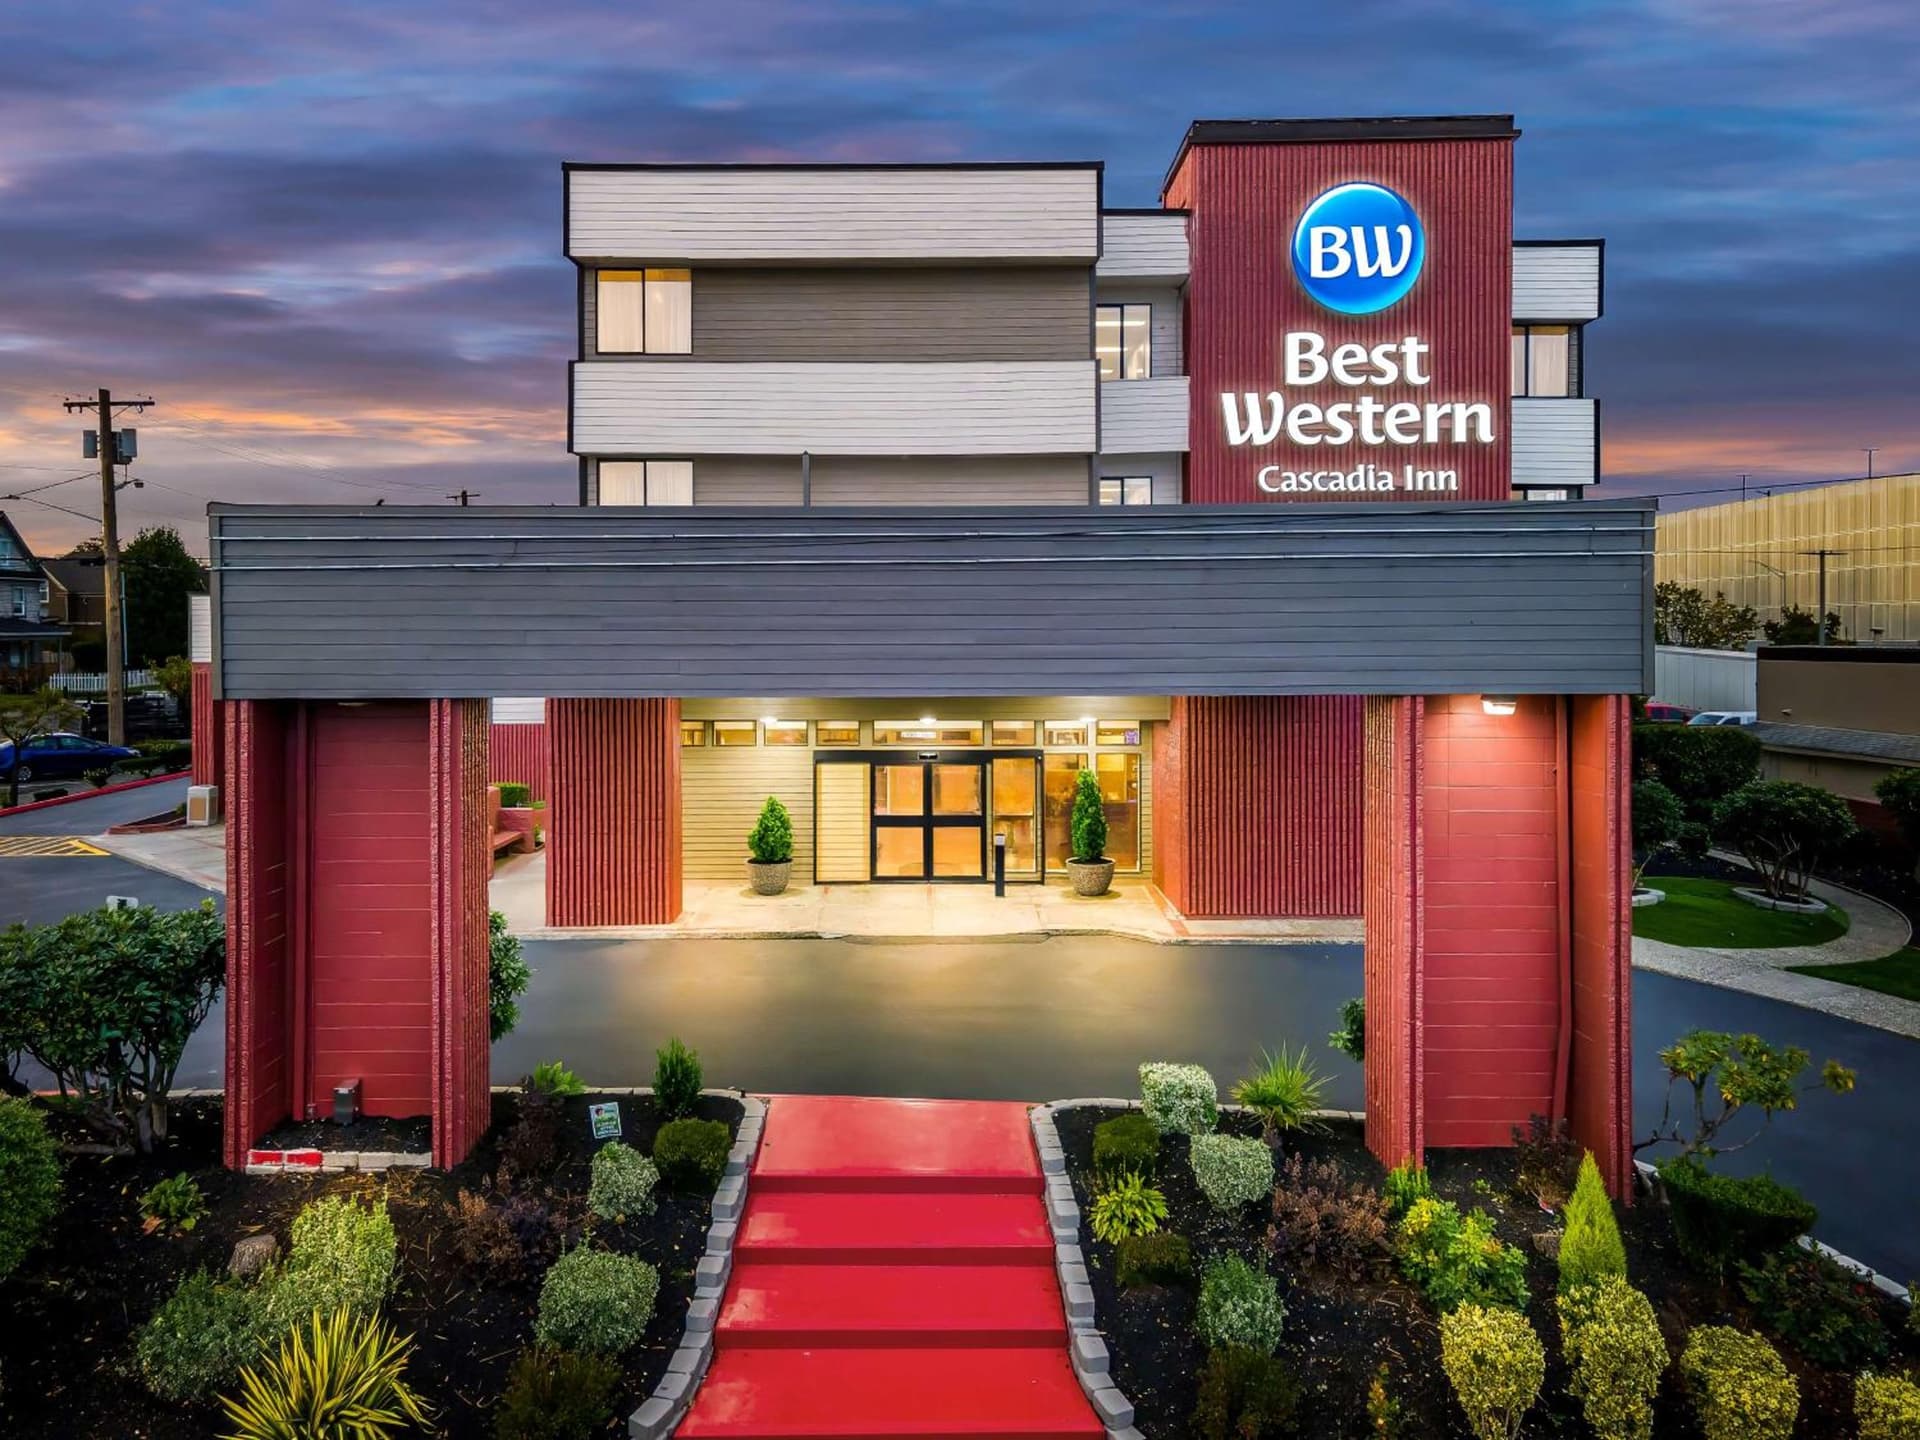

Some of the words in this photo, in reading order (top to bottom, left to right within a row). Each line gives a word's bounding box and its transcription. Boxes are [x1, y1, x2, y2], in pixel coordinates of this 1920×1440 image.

[1310, 225, 1413, 278] BW
[1284, 331, 1430, 386] Best
[1220, 391, 1496, 446] Western
[1258, 463, 1395, 493] Cascadia
[1405, 464, 1458, 492] Inn
